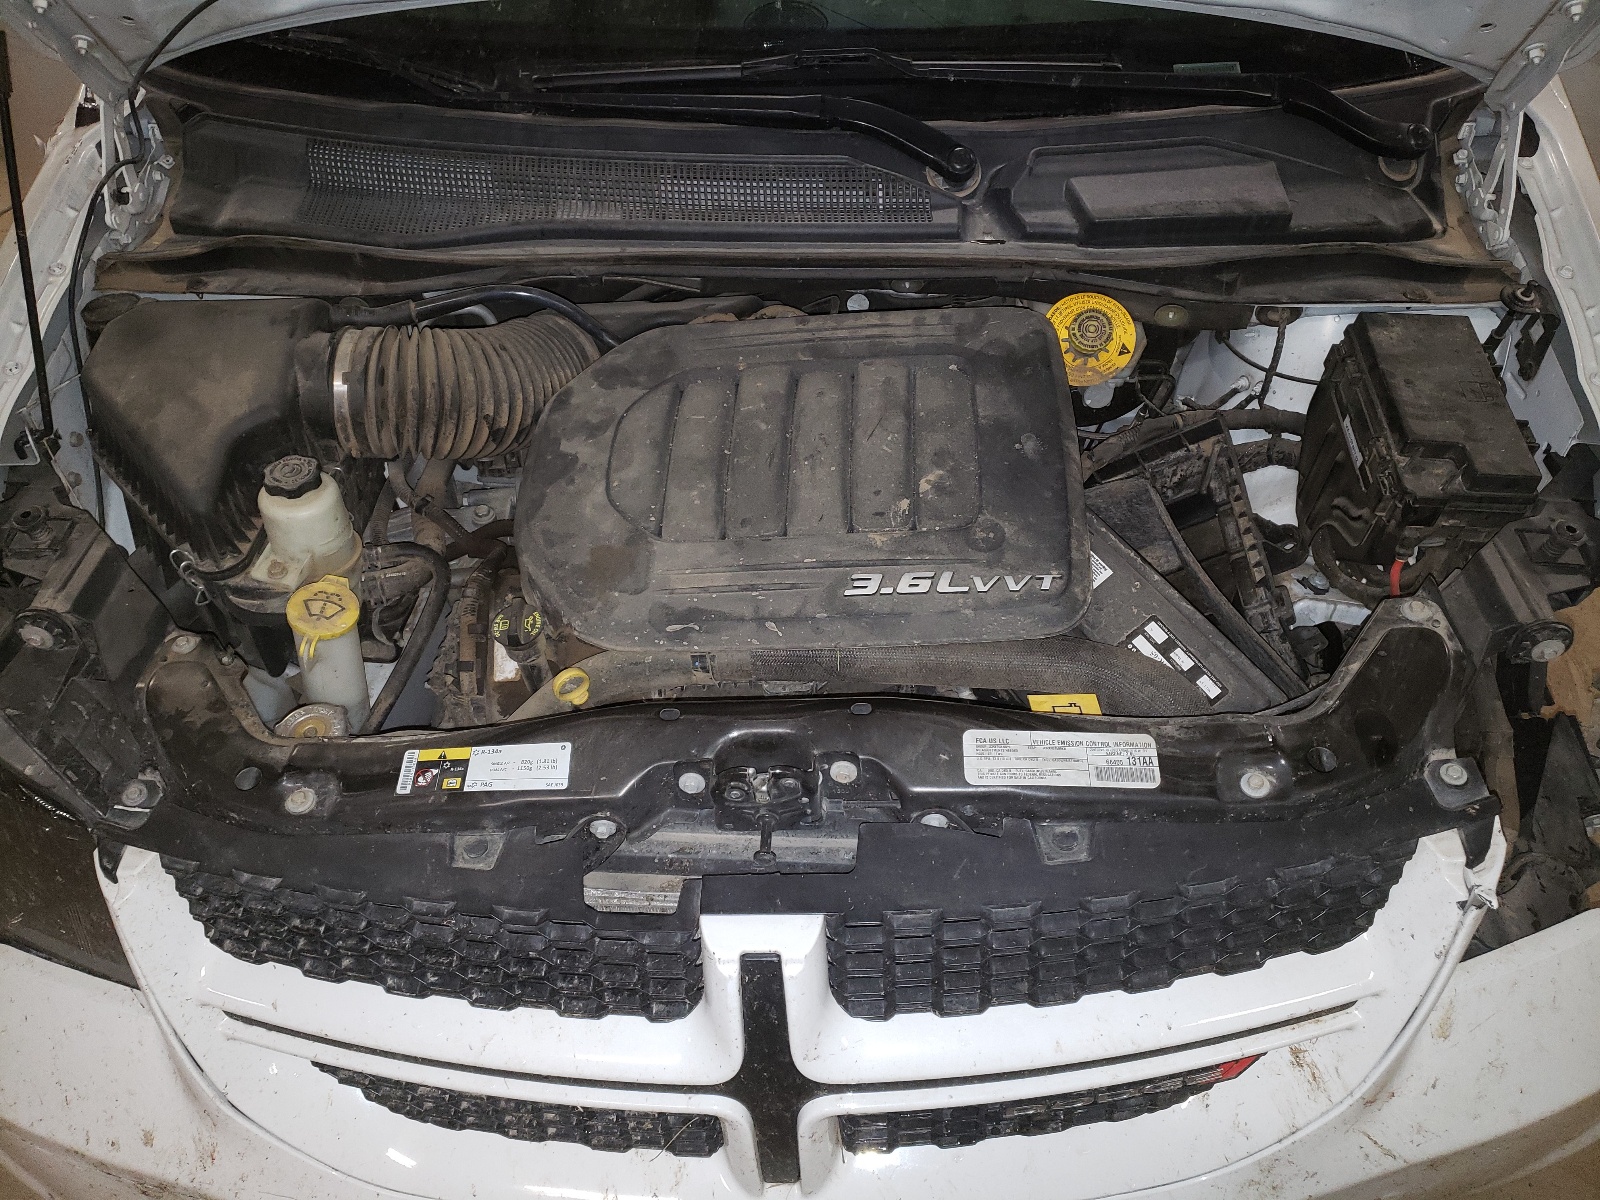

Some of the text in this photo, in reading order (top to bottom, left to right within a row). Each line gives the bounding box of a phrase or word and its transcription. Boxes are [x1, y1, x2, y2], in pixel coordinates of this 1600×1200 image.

[843, 571, 1063, 596] 3.6L VVT
[998, 737, 1010, 745] LLC
[1085, 740, 1112, 748] CONTROL
[1112, 741, 1152, 749] INFORMATION
[1126, 756, 1155, 766] 131AA
